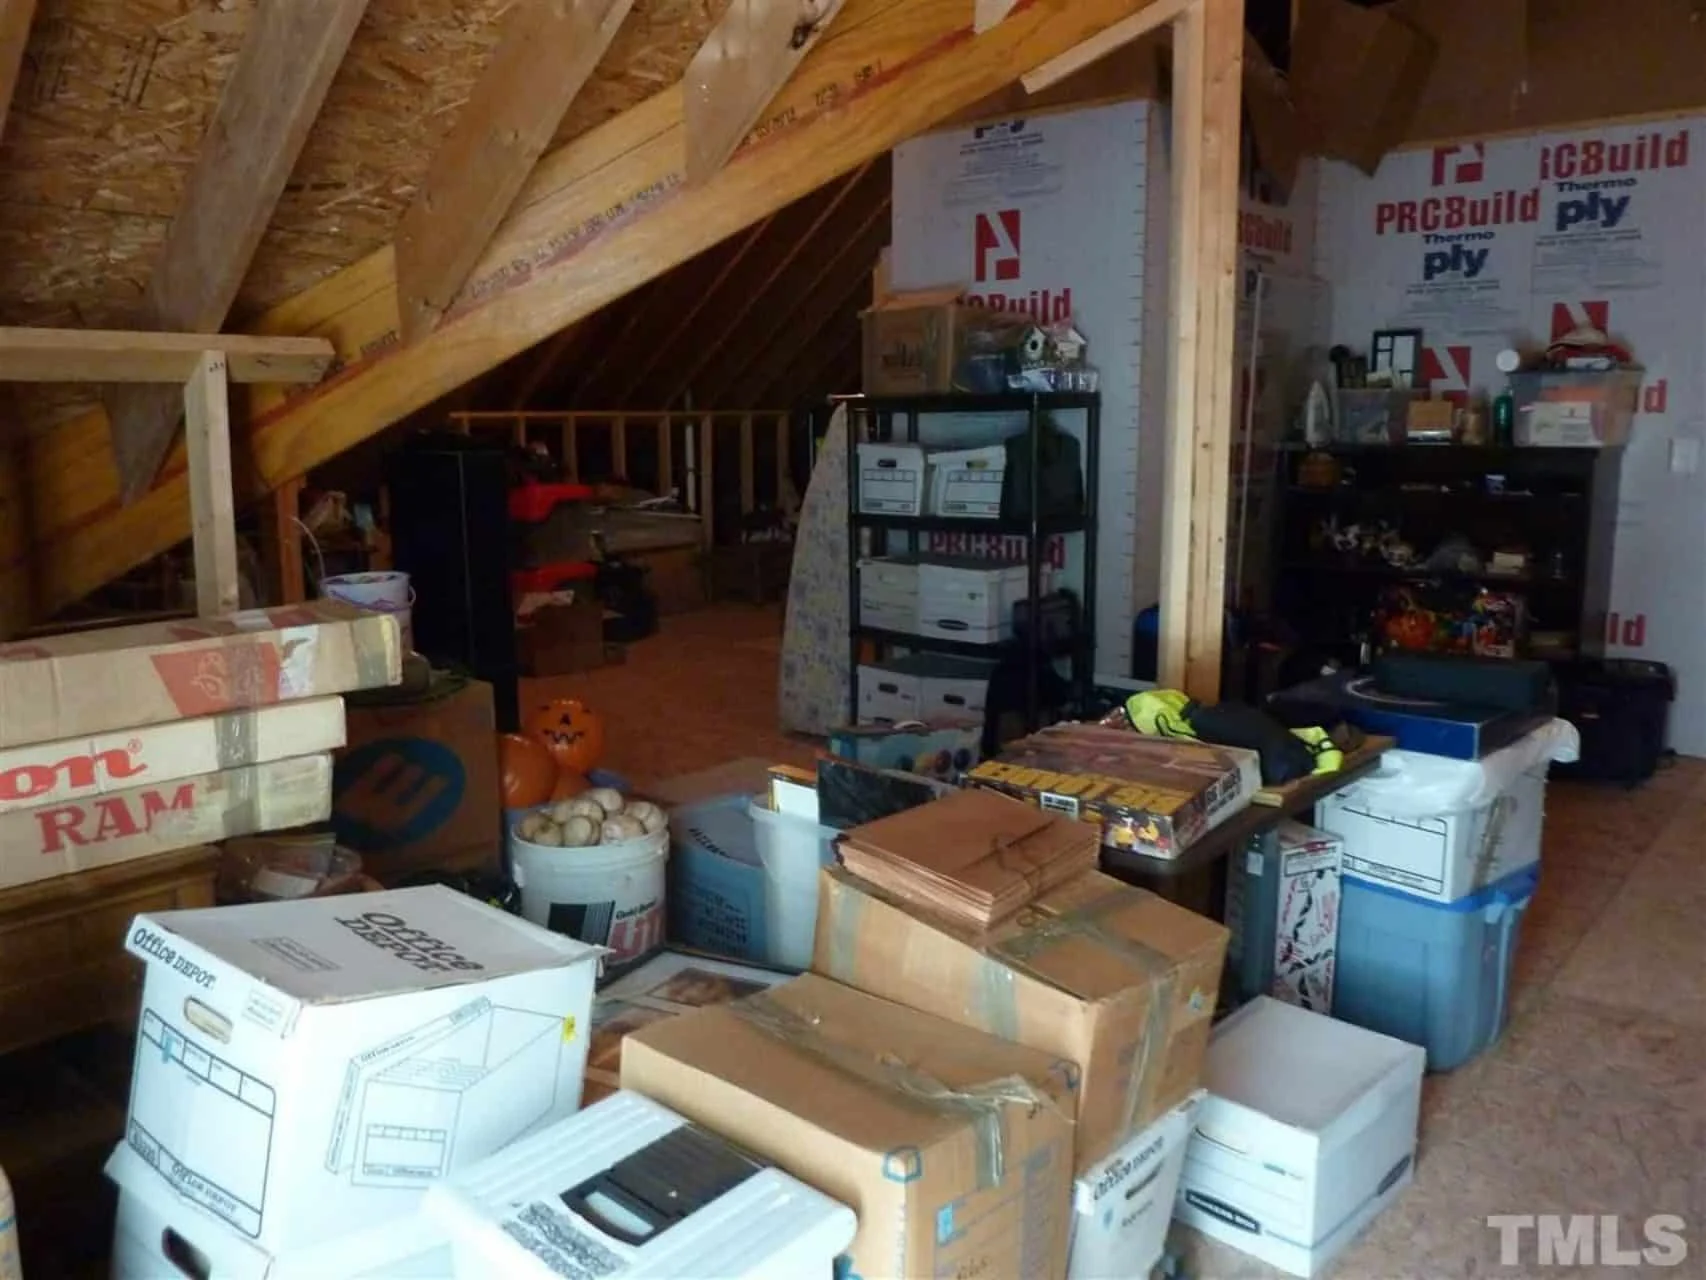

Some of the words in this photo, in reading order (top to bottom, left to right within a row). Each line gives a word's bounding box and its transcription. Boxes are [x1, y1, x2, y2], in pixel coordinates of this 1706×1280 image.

[1554, 178, 1638, 192] Thermo
[1556, 191, 1632, 232] ply
[1422, 231, 1496, 244] Thermo
[1423, 243, 1490, 281] ply
[35, 783, 195, 854] RAM
[133, 927, 177, 965] Office
[173, 956, 217, 989] DEPOT
[333, 916, 453, 972] DEPOT
[362, 912, 485, 970] Office
